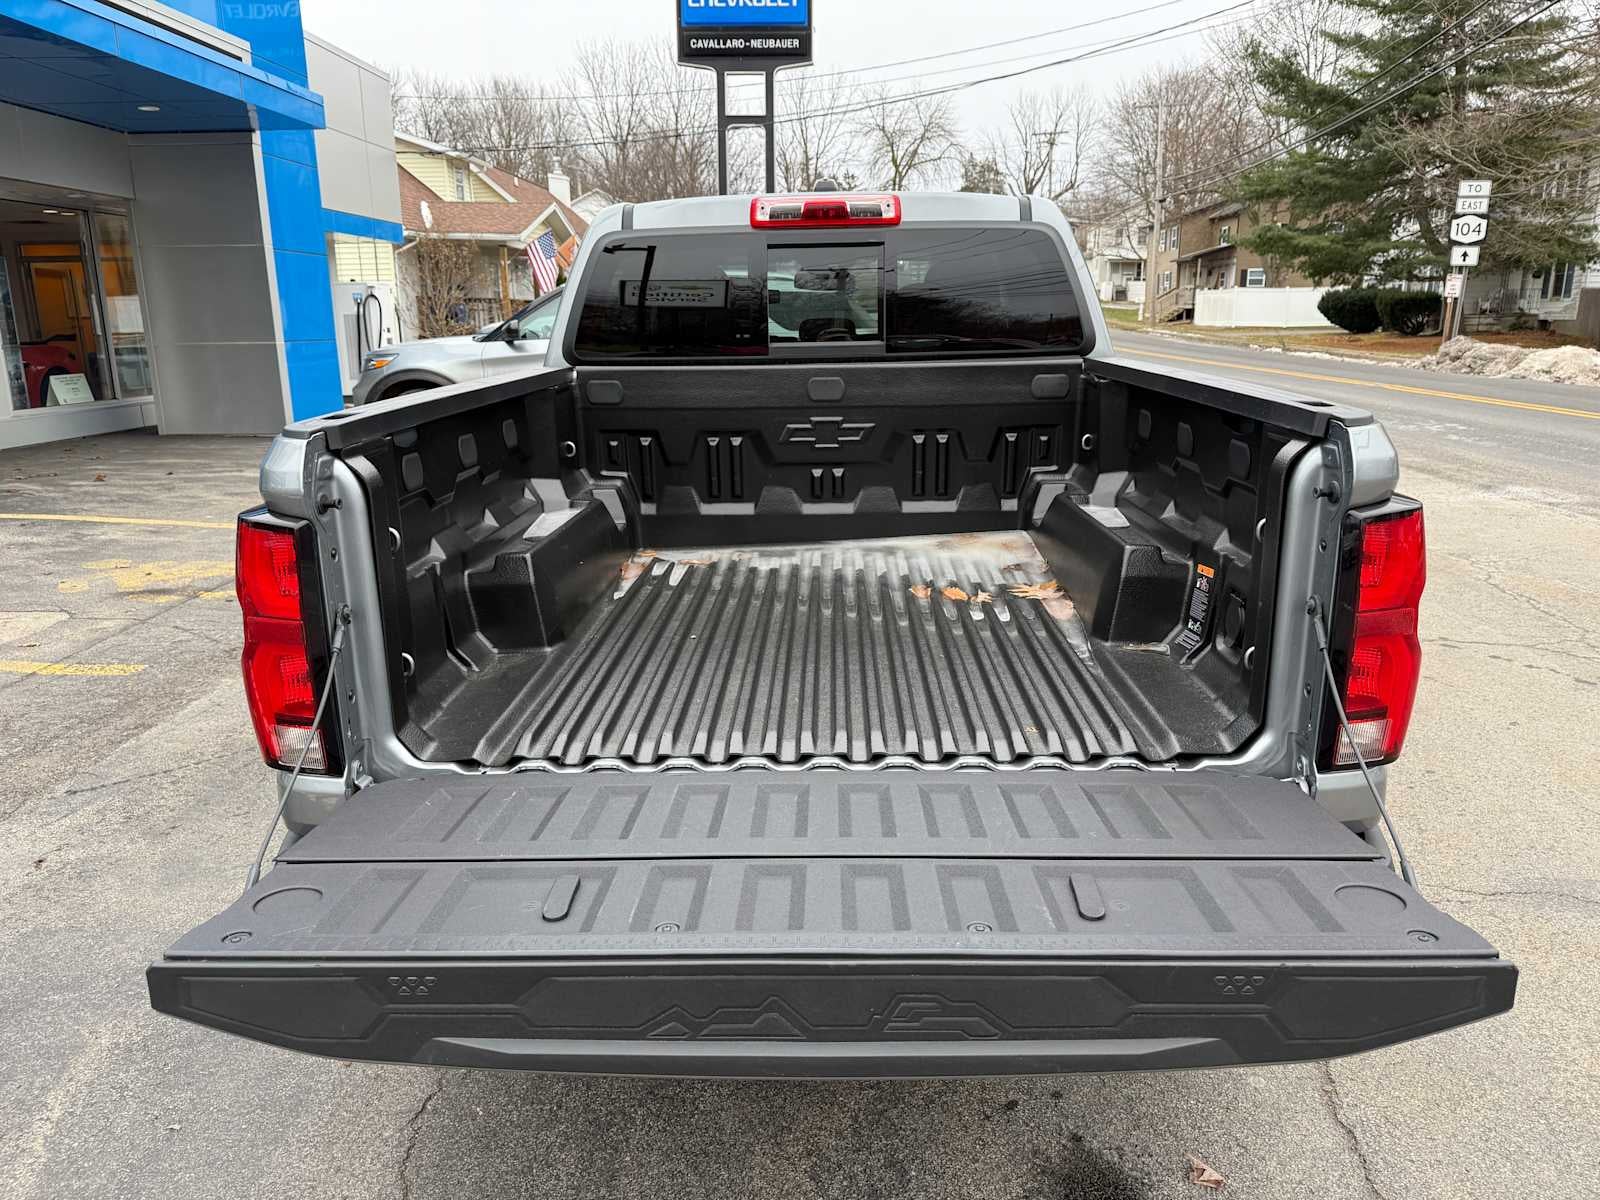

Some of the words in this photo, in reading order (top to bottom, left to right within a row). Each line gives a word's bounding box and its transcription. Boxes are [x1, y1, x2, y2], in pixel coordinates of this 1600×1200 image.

[690, 38, 800, 49] CAVALLARO-NEUBAUER
[1467, 184, 1482, 193] TO
[1461, 200, 1483, 210] EAST
[1455, 222, 1482, 236] 104
